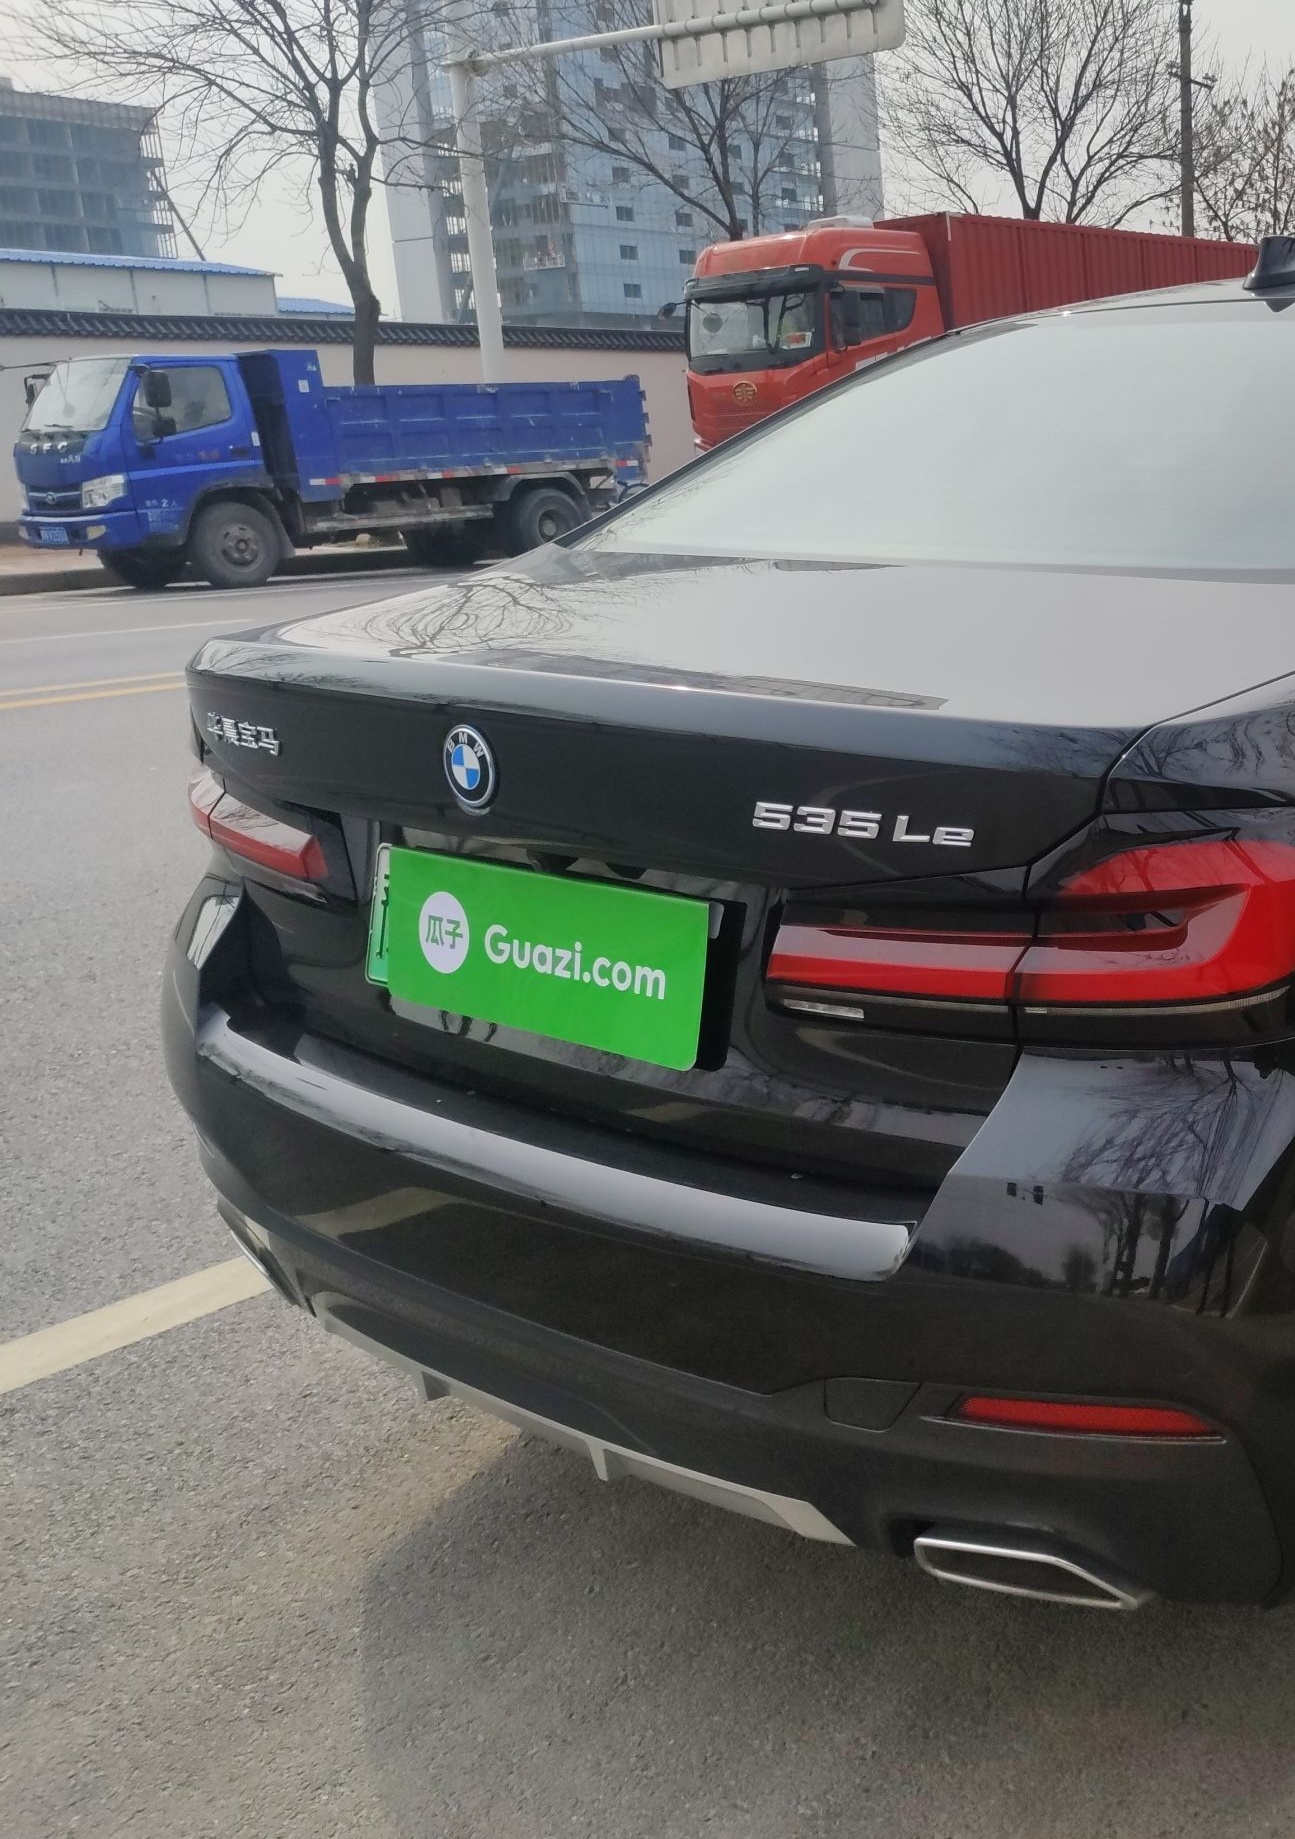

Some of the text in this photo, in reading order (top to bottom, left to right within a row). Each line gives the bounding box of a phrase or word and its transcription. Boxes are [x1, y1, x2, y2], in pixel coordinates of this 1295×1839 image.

[207, 712, 280, 756] 华晨宝马
[446, 731, 485, 758] BMW
[752, 801, 975, 847] 535 Le
[425, 914, 464, 950] 瓜子
[484, 924, 666, 1001] Guazi.com
